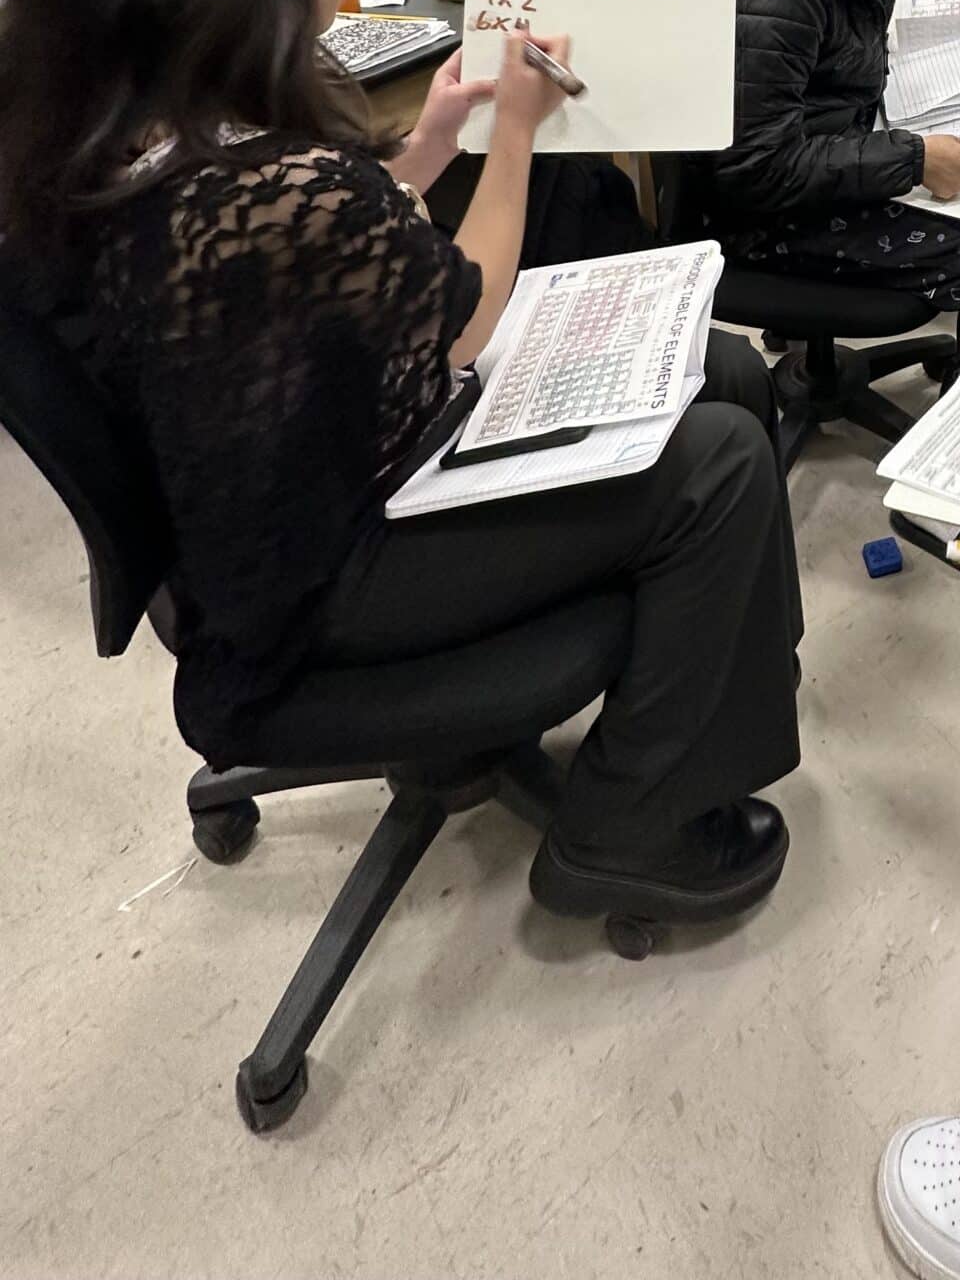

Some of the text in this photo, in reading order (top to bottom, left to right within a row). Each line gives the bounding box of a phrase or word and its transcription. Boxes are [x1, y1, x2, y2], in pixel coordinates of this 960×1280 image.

[674, 291, 693, 324] TABLE
[669, 323, 685, 339] OF
[650, 339, 679, 410] ELEMENTS
